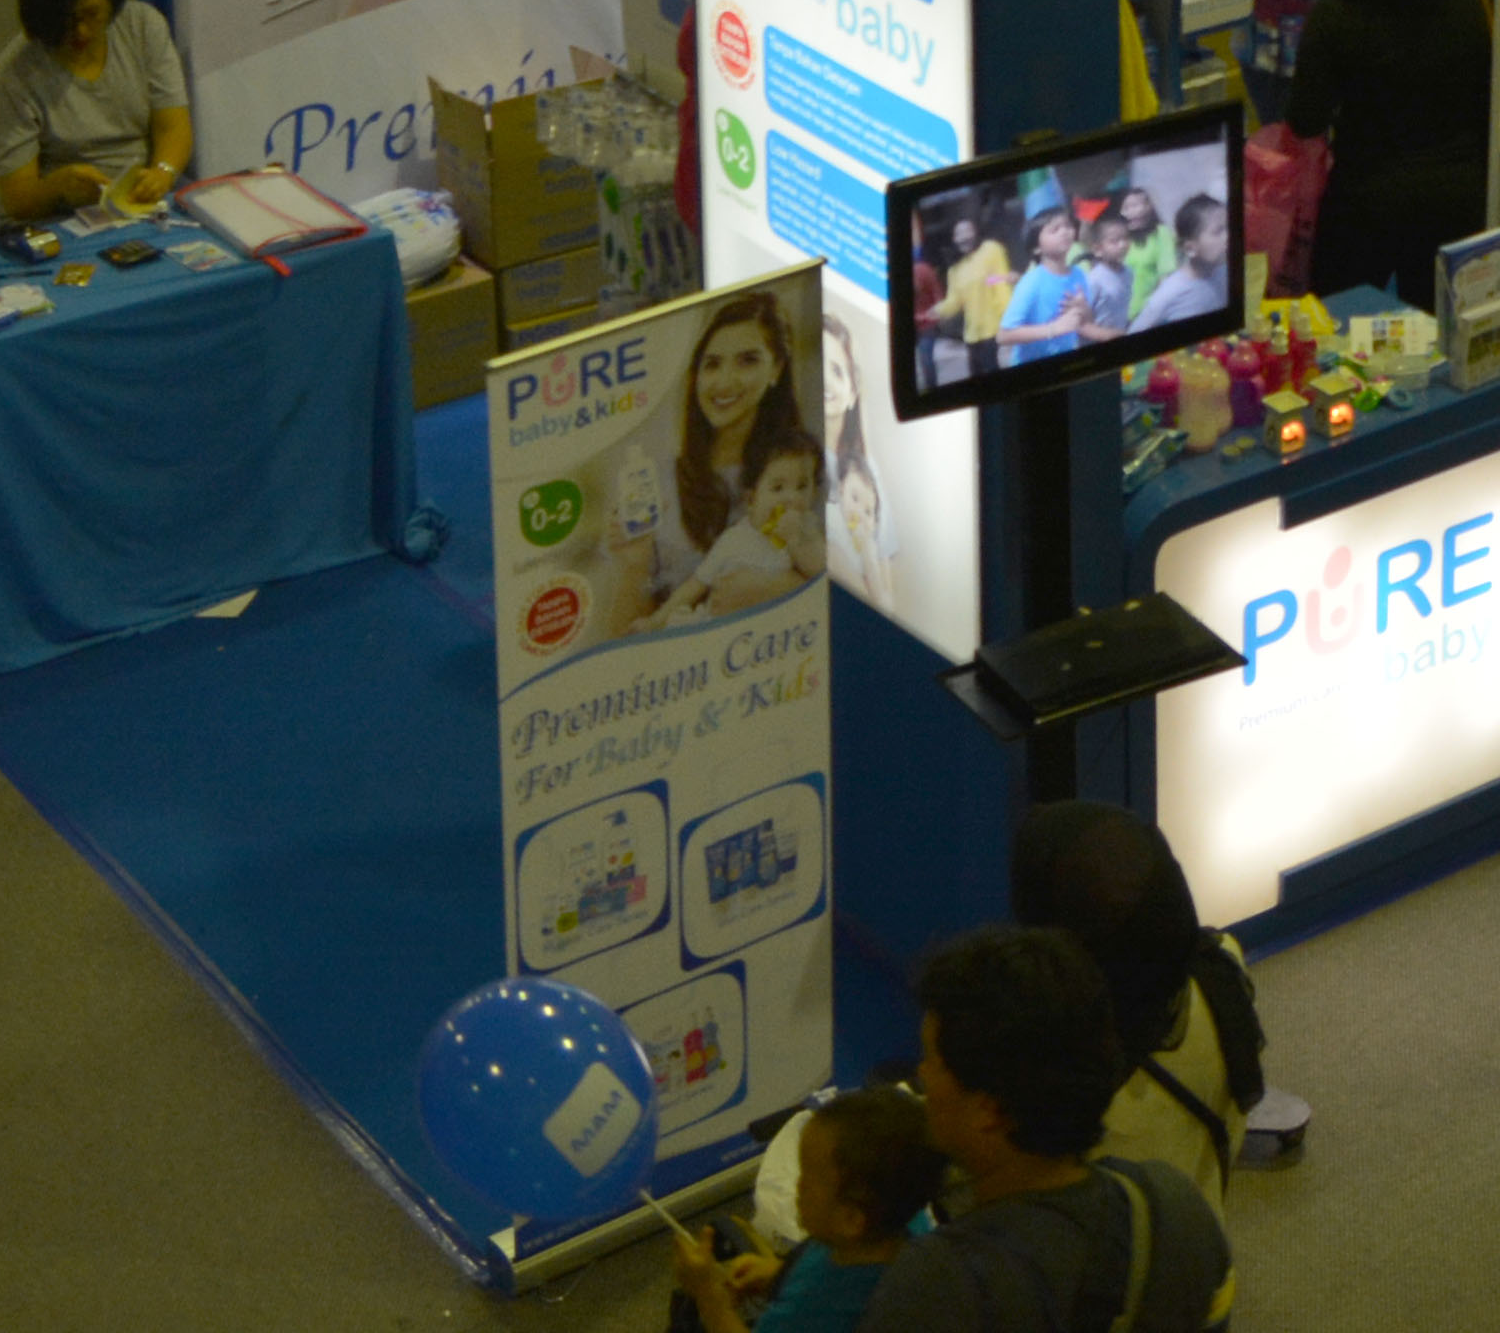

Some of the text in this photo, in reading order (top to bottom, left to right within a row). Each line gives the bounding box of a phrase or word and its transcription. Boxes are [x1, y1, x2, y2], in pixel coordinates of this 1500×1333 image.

[507, 336, 649, 420] PURE
[530, 498, 574, 532] 0-2
[1241, 511, 1495, 687] PURE
[514, 618, 820, 760] Premium Care
[1380, 618, 1494, 686] baby
[515, 655, 821, 805] For Baby & Kids
[569, 1087, 626, 1155] MAM
